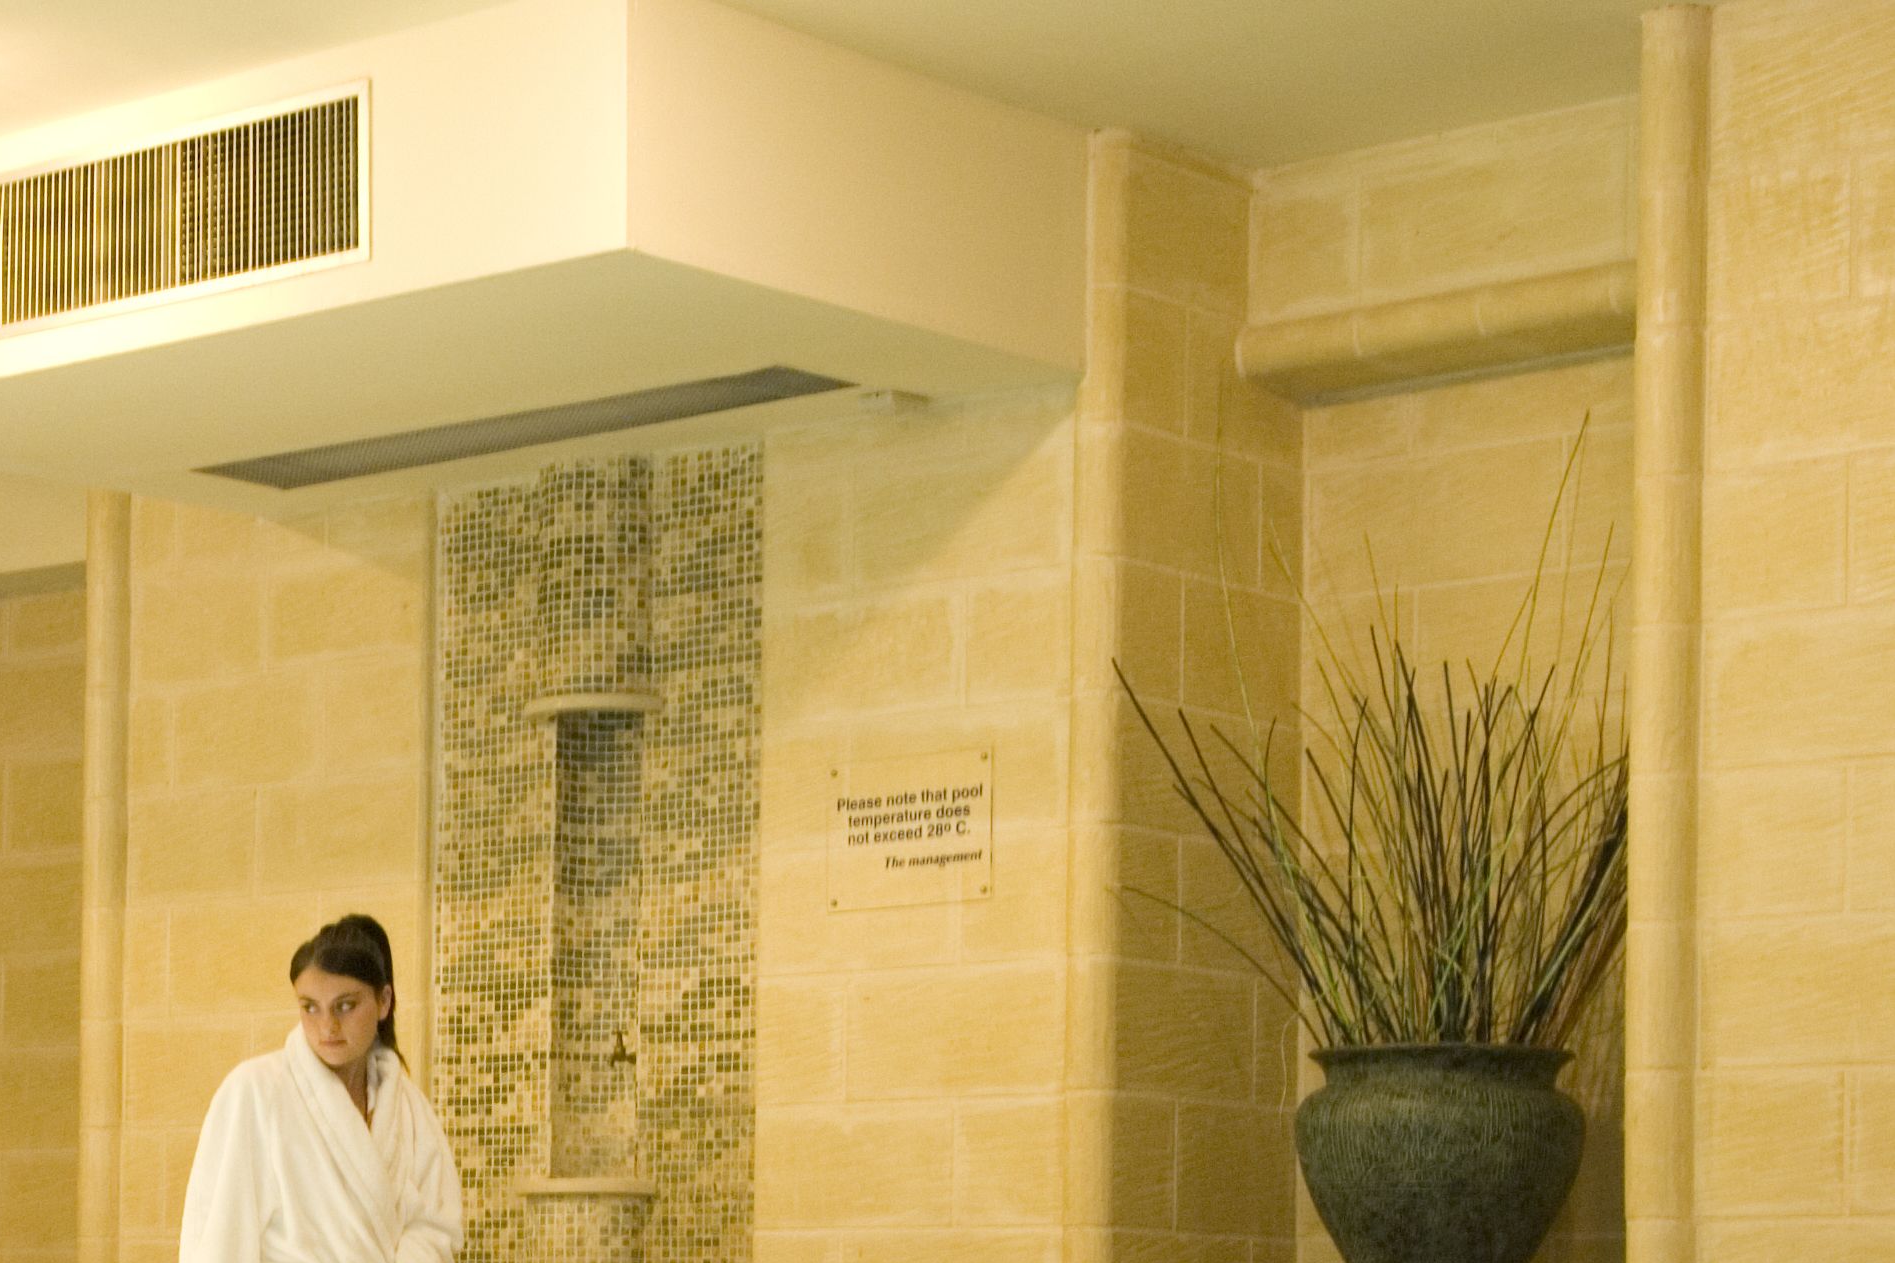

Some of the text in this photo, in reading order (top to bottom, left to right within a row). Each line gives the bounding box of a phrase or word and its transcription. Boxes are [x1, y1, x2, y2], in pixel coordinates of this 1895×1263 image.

[837, 783, 983, 812] Please note that pool
[848, 804, 970, 829] temperature does
[848, 832, 869, 846] not
[873, 826, 923, 842] exceed
[885, 849, 983, 869] The management
